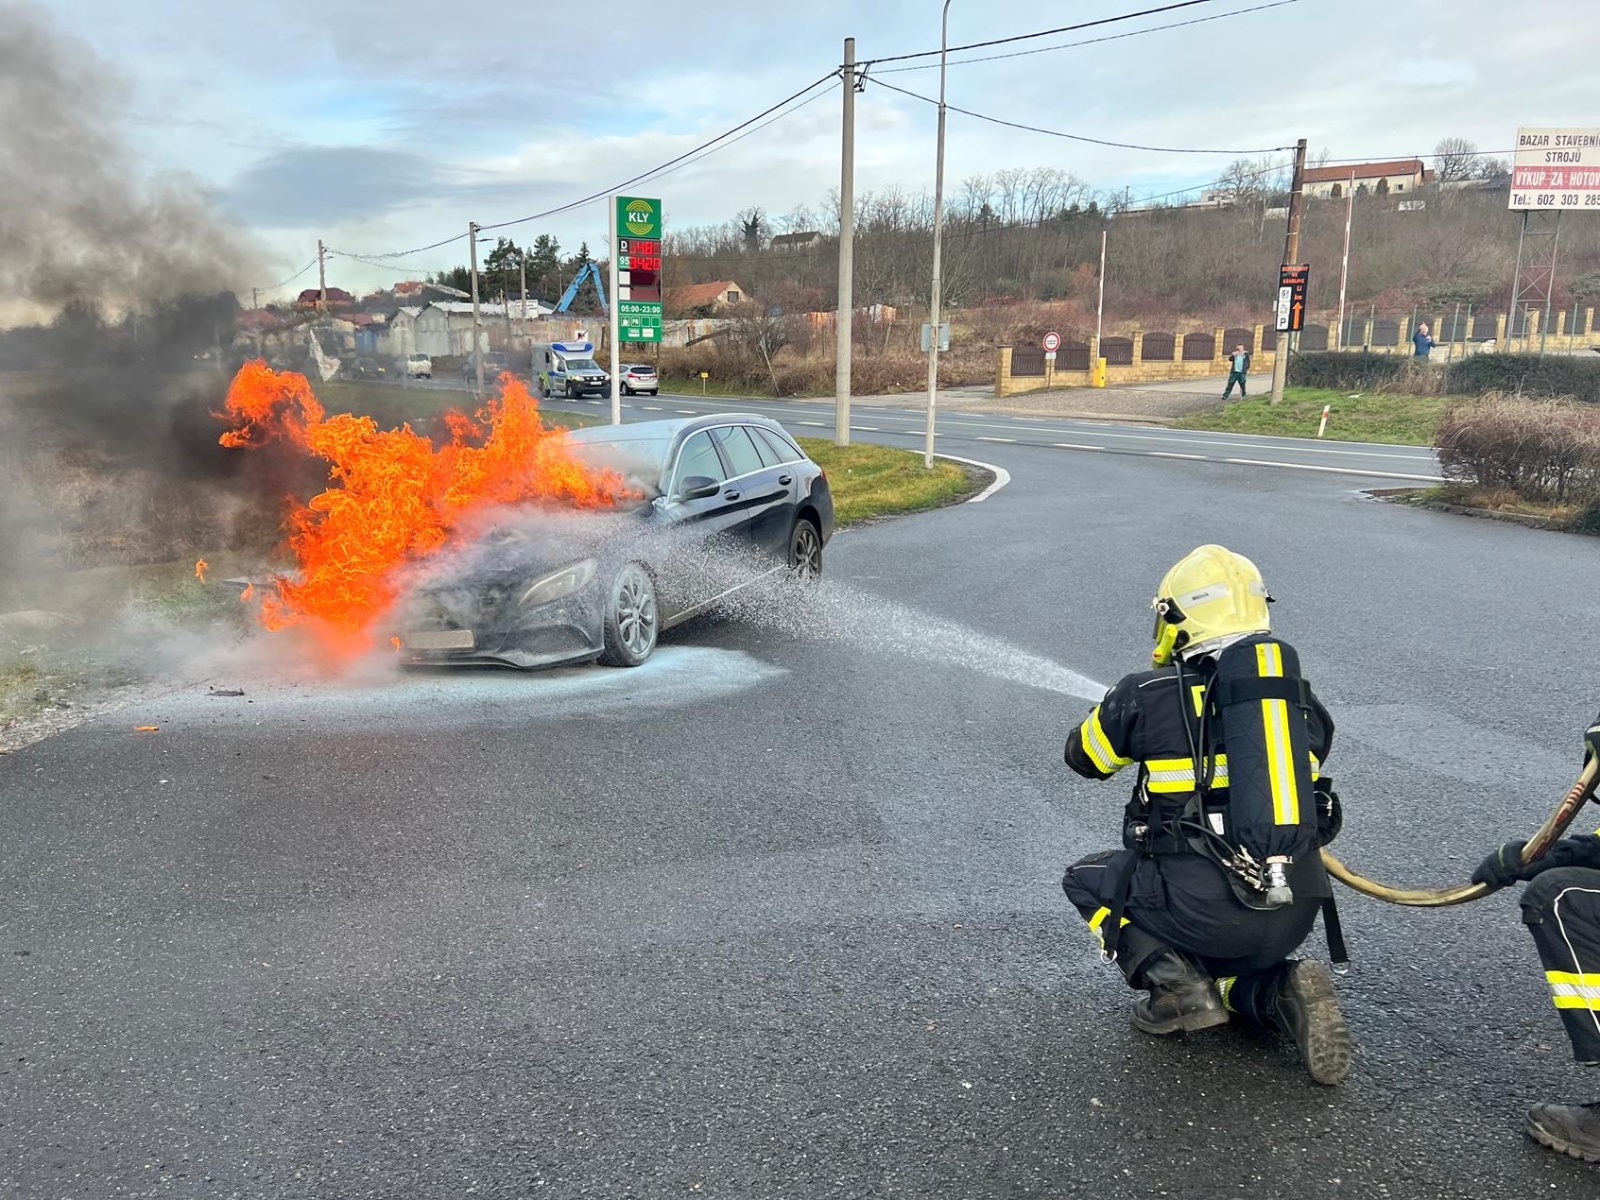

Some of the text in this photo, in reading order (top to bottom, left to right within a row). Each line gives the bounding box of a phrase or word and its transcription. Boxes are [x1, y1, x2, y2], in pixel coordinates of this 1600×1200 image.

[1519, 135, 1549, 146] BAZAR
[1516, 168, 1546, 186] VÝKUP
[1550, 171, 1562, 186] ZA
[1513, 194, 1531, 205] Tel.:
[1537, 194, 1555, 206] 602
[1561, 194, 1579, 206] 303
[628, 212, 650, 223] KLY
[620, 240, 628, 249] D
[620, 256, 630, 264] 95
[1280, 318, 1286, 326] P
